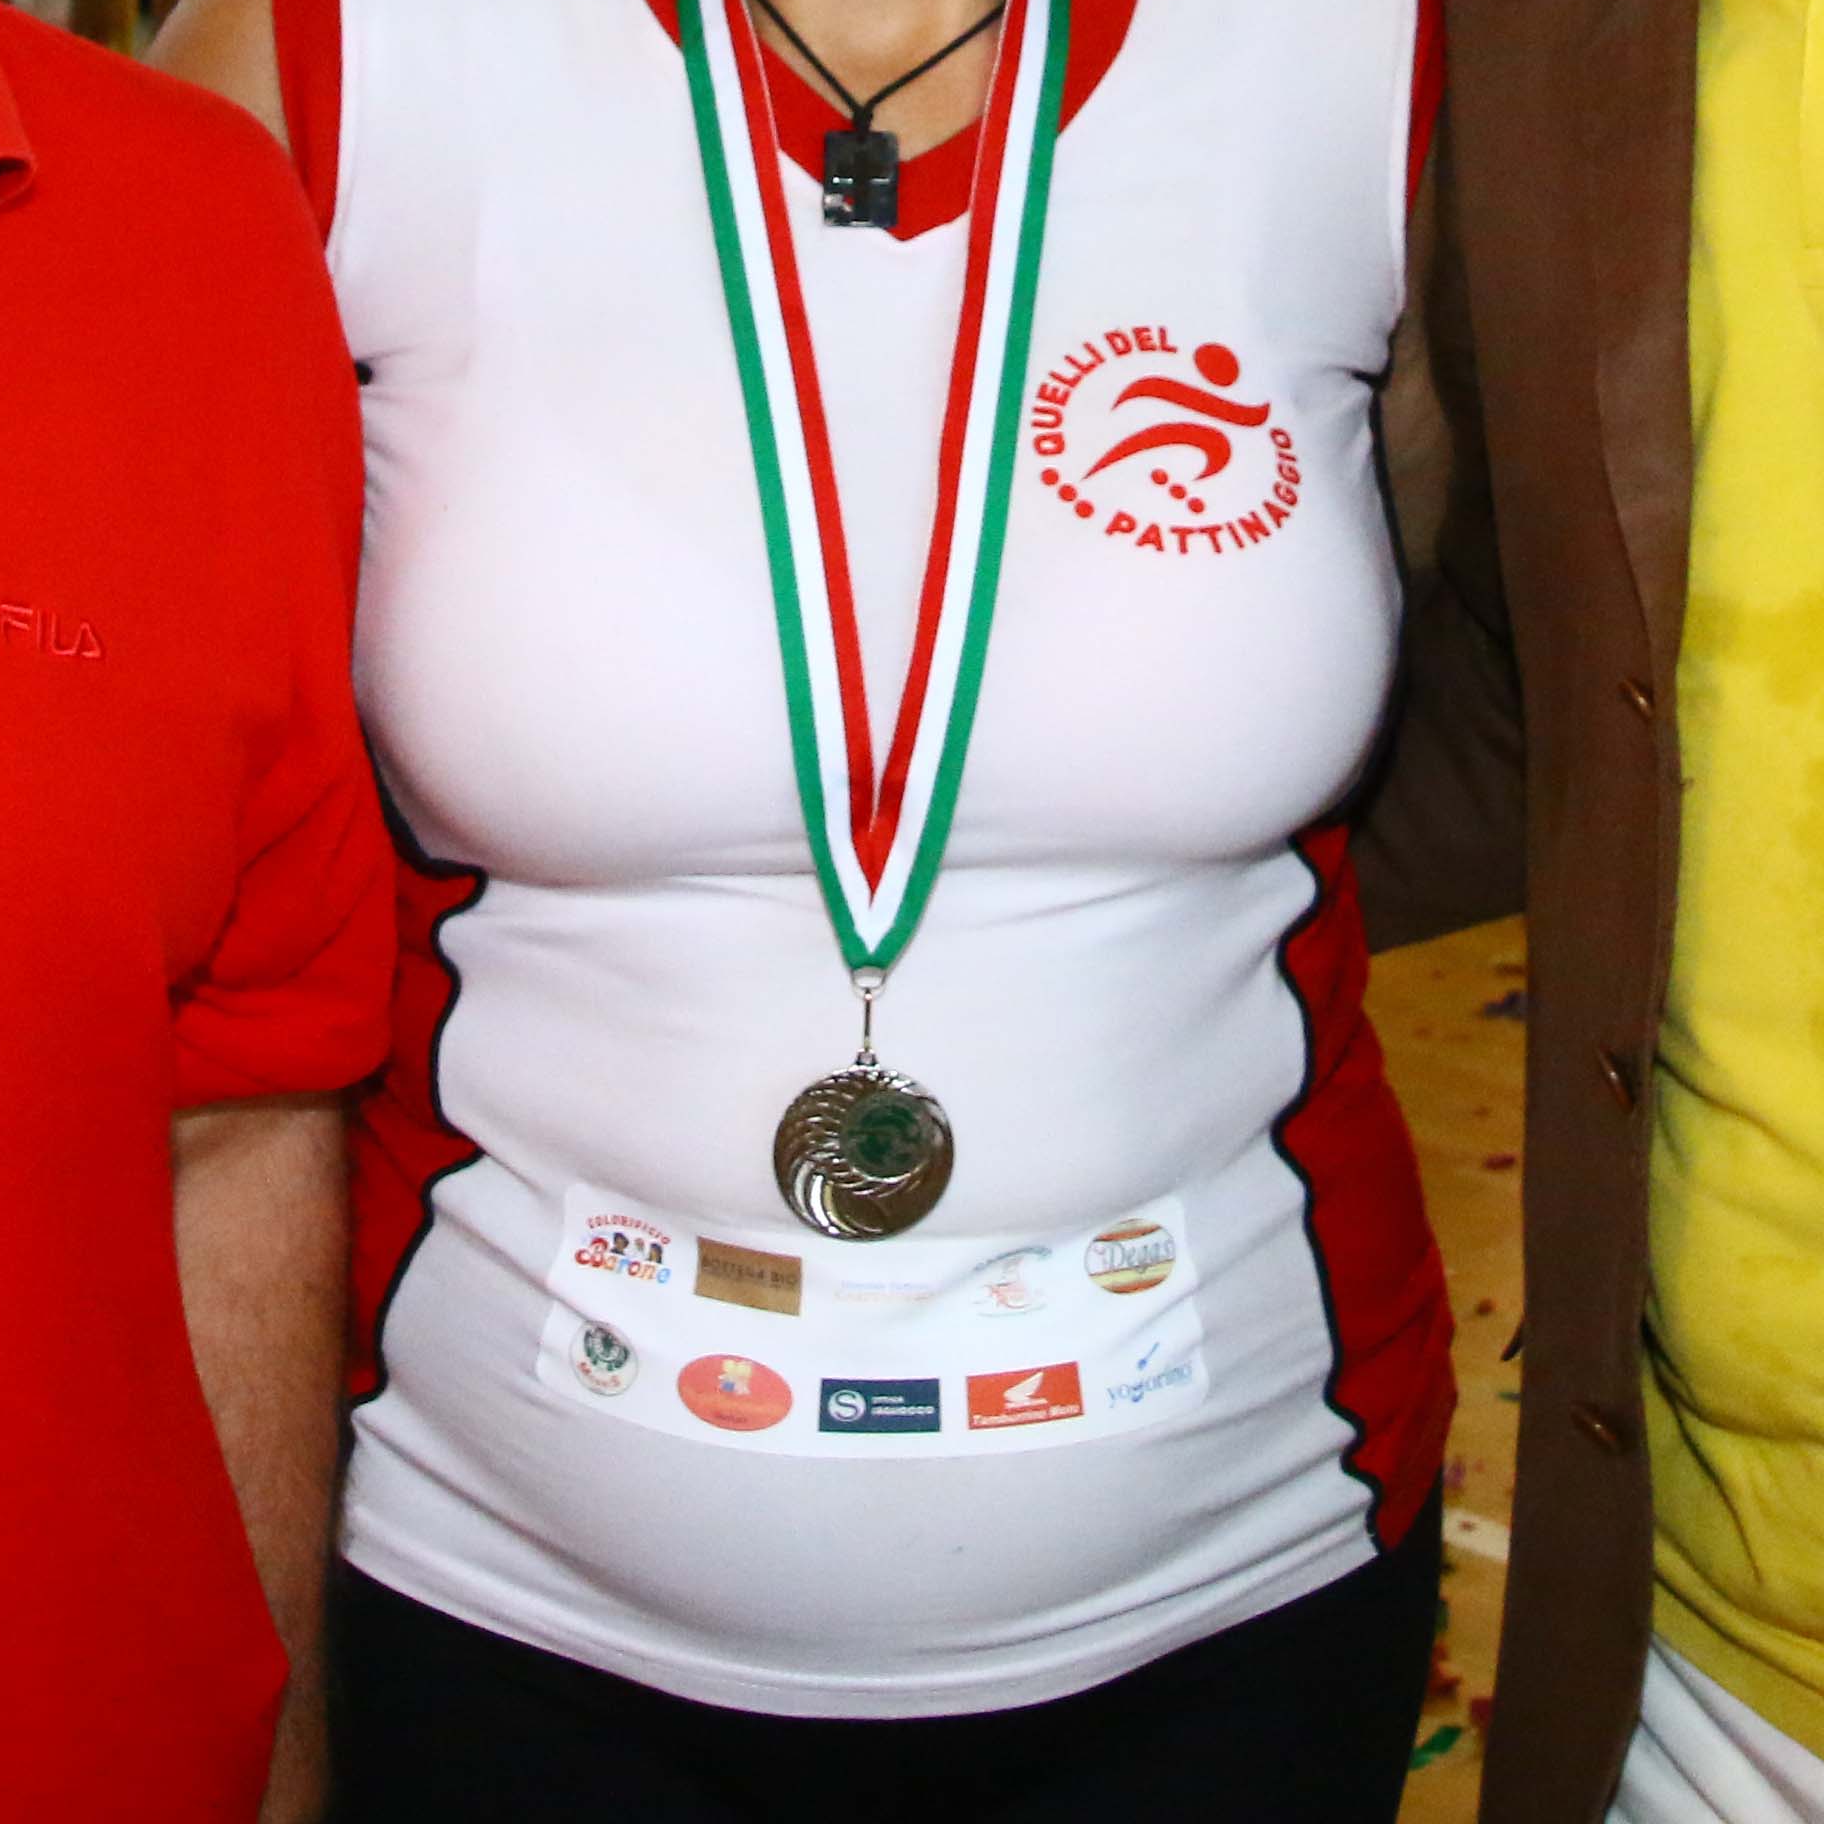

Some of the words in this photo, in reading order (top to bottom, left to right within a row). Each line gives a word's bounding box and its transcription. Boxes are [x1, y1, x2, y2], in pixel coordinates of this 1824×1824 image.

[1030, 341, 1106, 457] QUELLI
[1103, 326, 1179, 357] DEL
[1104, 427, 1302, 555] PATTINAGGIO
[0, 603, 102, 659] FILA
